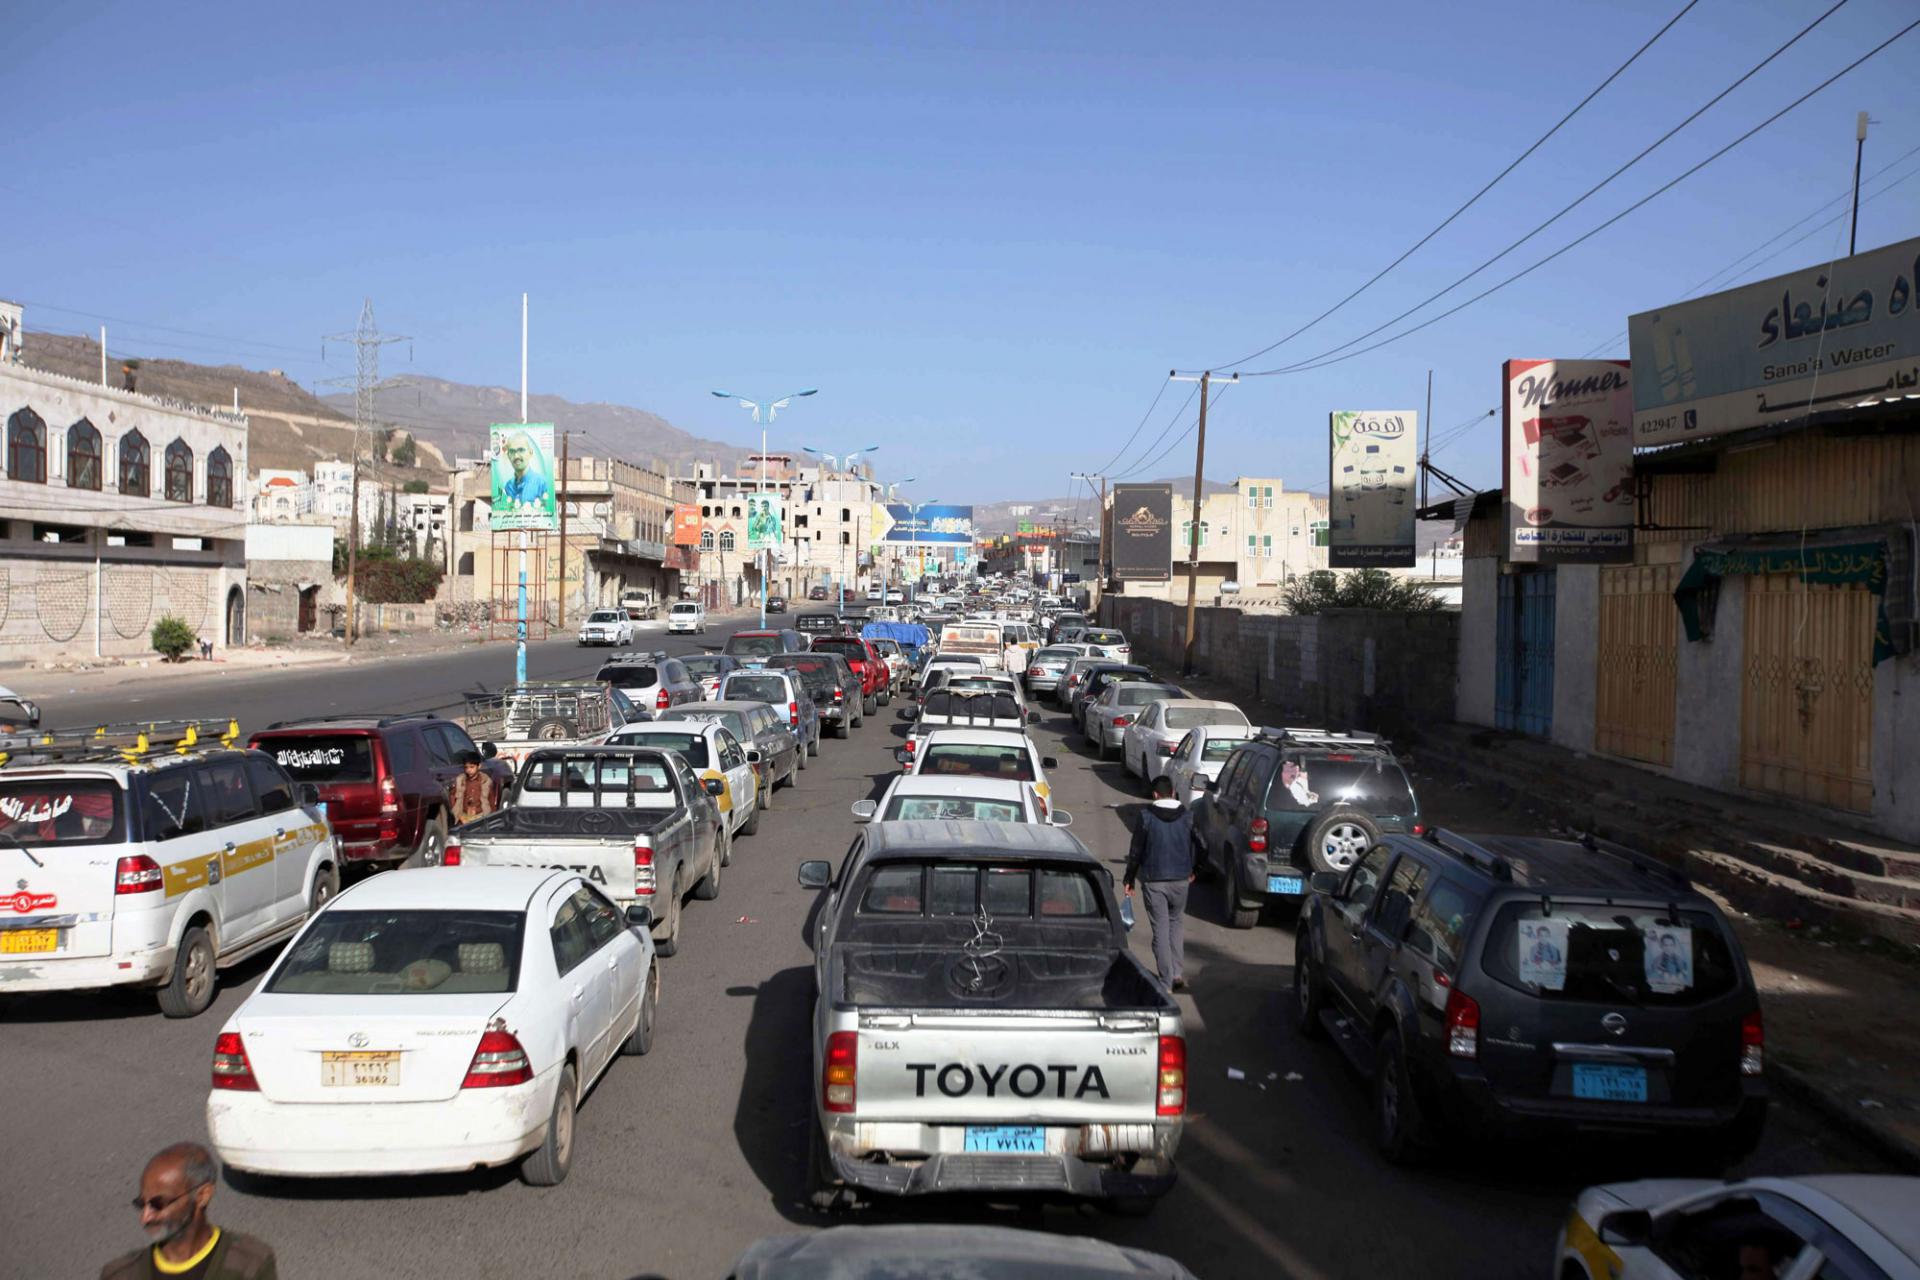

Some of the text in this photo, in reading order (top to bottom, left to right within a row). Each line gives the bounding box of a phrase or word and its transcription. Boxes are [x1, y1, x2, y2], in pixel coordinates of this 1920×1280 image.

[1758, 274, 1873, 349] صنعاء
[1763, 344, 1895, 380] Sana'a Water
[1640, 416, 1678, 434] 422947
[906, 1063, 1110, 1099] TOYOTA
